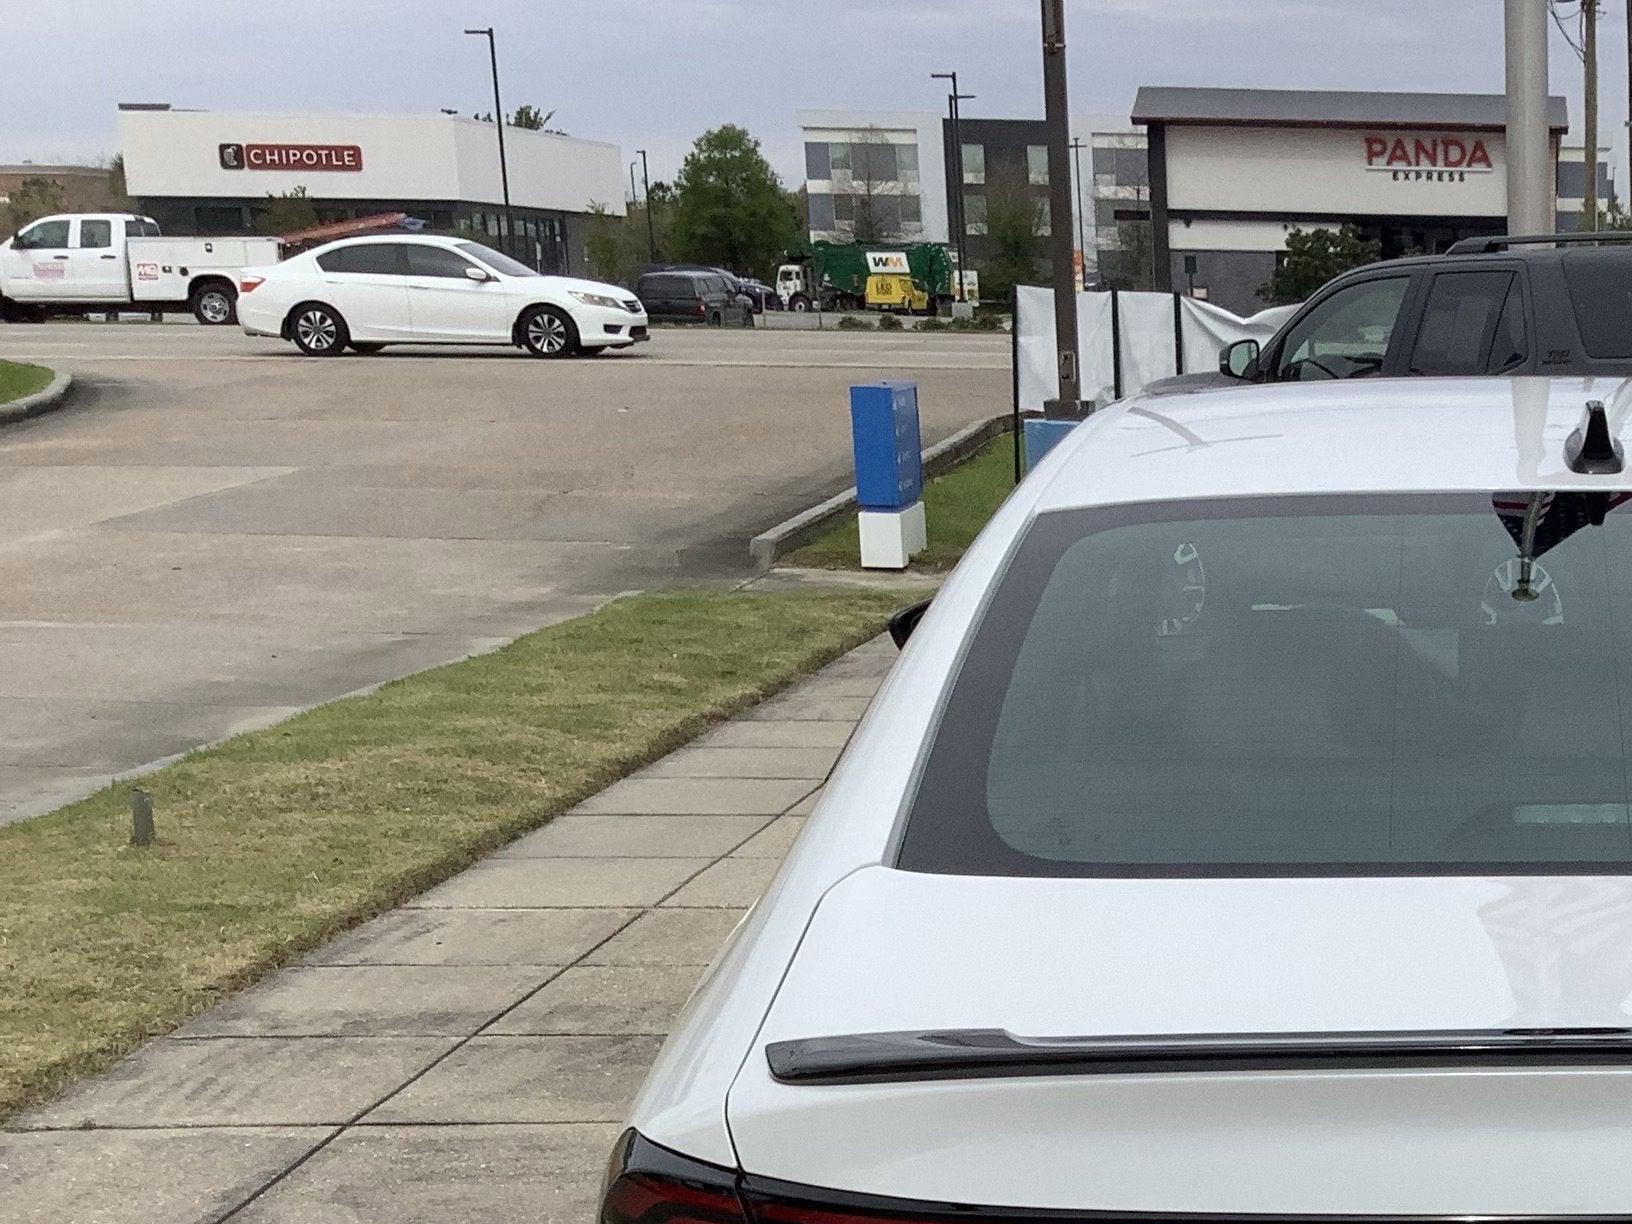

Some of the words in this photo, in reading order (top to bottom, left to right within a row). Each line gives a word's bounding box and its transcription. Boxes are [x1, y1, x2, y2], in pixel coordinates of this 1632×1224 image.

[249, 149, 357, 166] CHIPOTLE
[1364, 137, 1493, 168] PANDA
[1392, 170, 1465, 182] EXPRESS
[872, 256, 904, 268] WM
